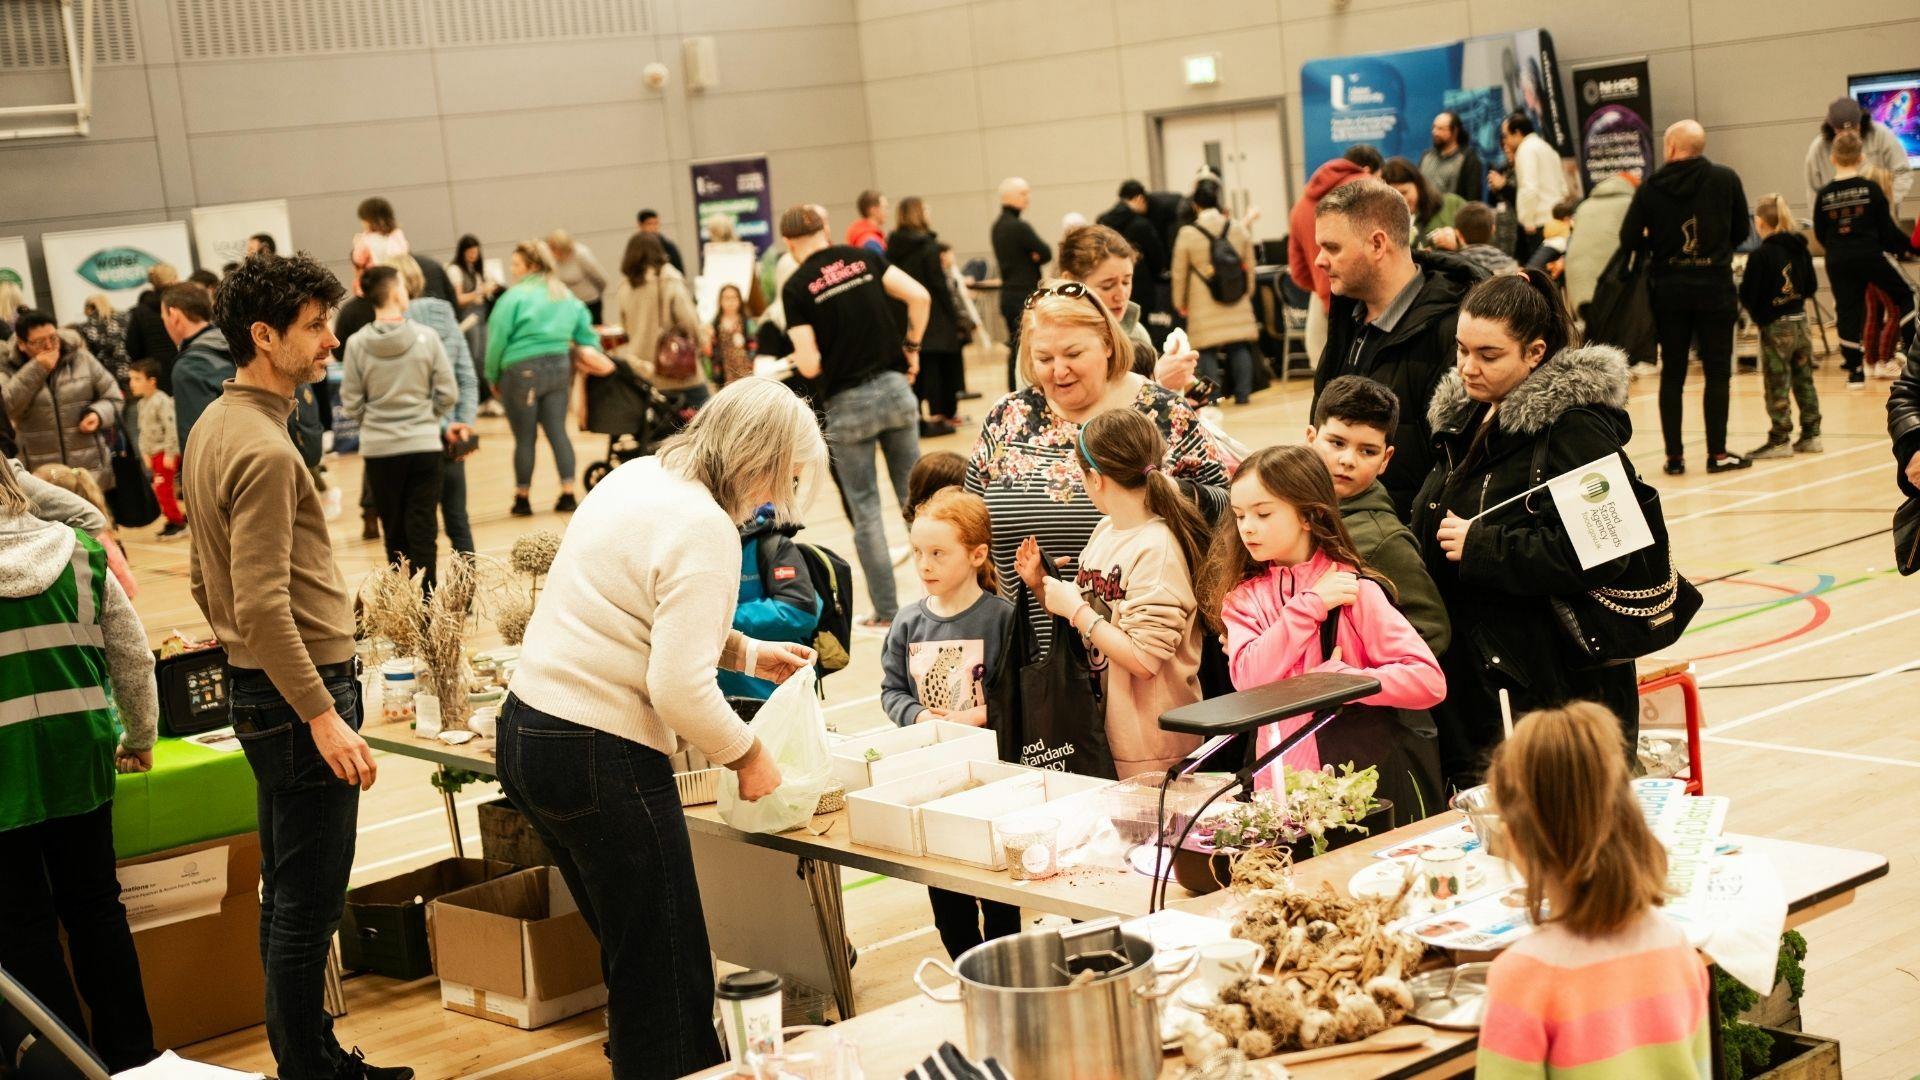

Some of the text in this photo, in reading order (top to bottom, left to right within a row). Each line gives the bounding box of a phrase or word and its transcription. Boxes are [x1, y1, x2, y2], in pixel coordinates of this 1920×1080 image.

[1590, 508, 1609, 541] Agency
[1599, 504, 1622, 548] Standards
[1607, 501, 1623, 524] Food
[1022, 738, 1045, 756] ood
